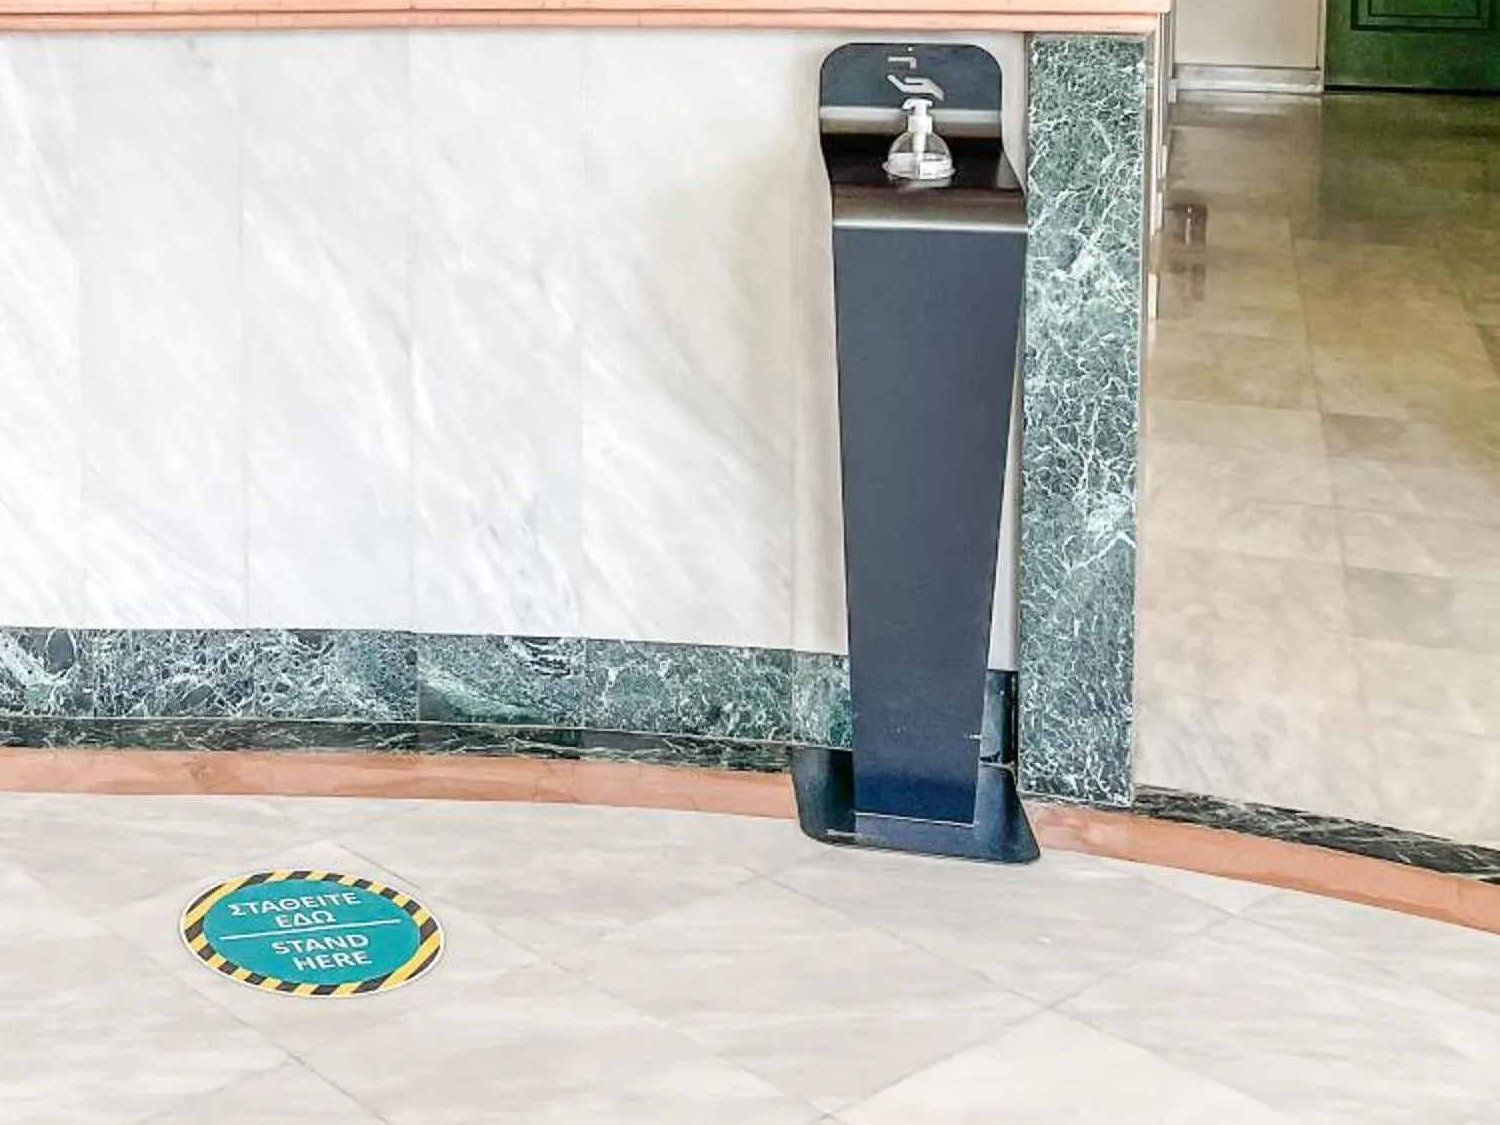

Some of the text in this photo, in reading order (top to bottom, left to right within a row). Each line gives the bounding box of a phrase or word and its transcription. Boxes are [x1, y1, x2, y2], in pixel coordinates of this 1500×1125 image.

[228, 891, 362, 917] ΣΤΑΘΕΙΤΕ
[275, 910, 337, 928] ΕΔΩ
[271, 933, 369, 956] STAND
[292, 950, 373, 972] HERE
